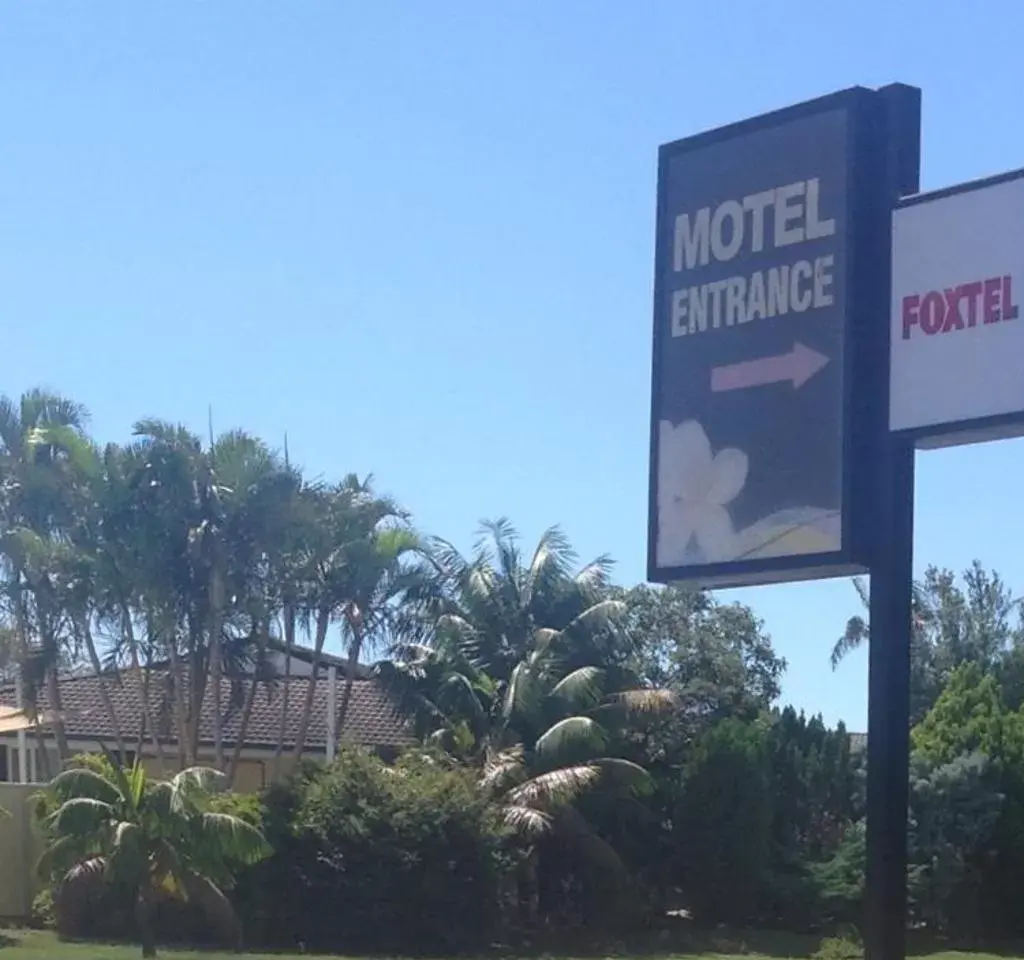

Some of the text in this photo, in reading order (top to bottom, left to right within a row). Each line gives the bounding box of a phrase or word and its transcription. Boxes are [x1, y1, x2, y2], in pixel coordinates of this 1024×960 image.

[674, 178, 835, 272] MOTEL
[672, 254, 834, 337] ENTRANCE
[901, 274, 1019, 339] FOXTEL
